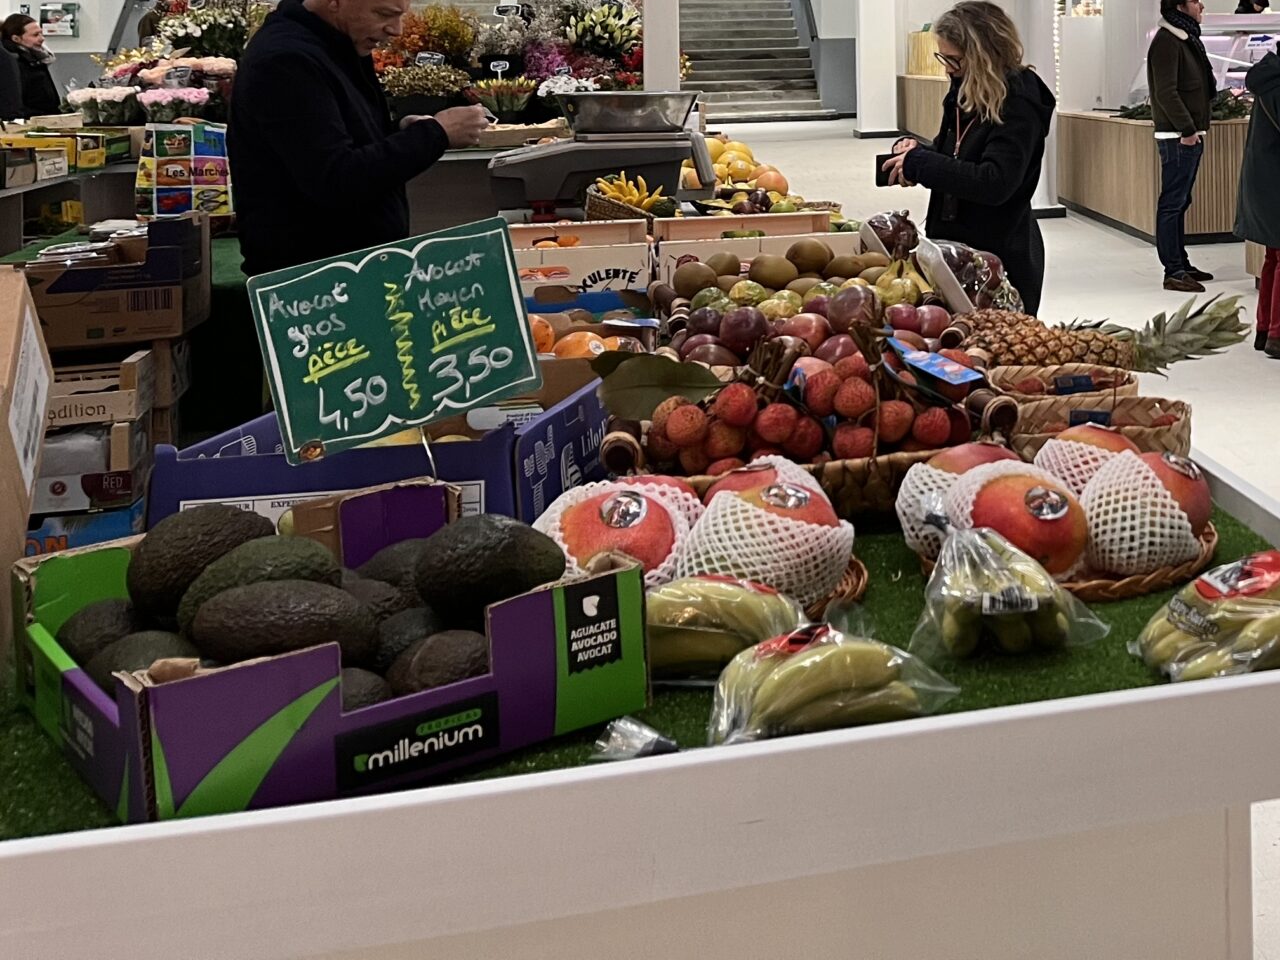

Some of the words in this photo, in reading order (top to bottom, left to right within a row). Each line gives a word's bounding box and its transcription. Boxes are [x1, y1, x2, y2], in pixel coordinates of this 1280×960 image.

[165, 167, 185, 178] Les
[404, 252, 485, 291] Avocat
[268, 282, 349, 322] Avocat
[428, 345, 513, 401] 3,50
[319, 375, 388, 432] 4,50
[102, 475, 123, 489] RED
[570, 618, 617, 640] AGUACATE
[571, 629, 617, 653] AVOCADO
[576, 644, 612, 663] AVOCAT
[367, 723, 483, 770] millenium
